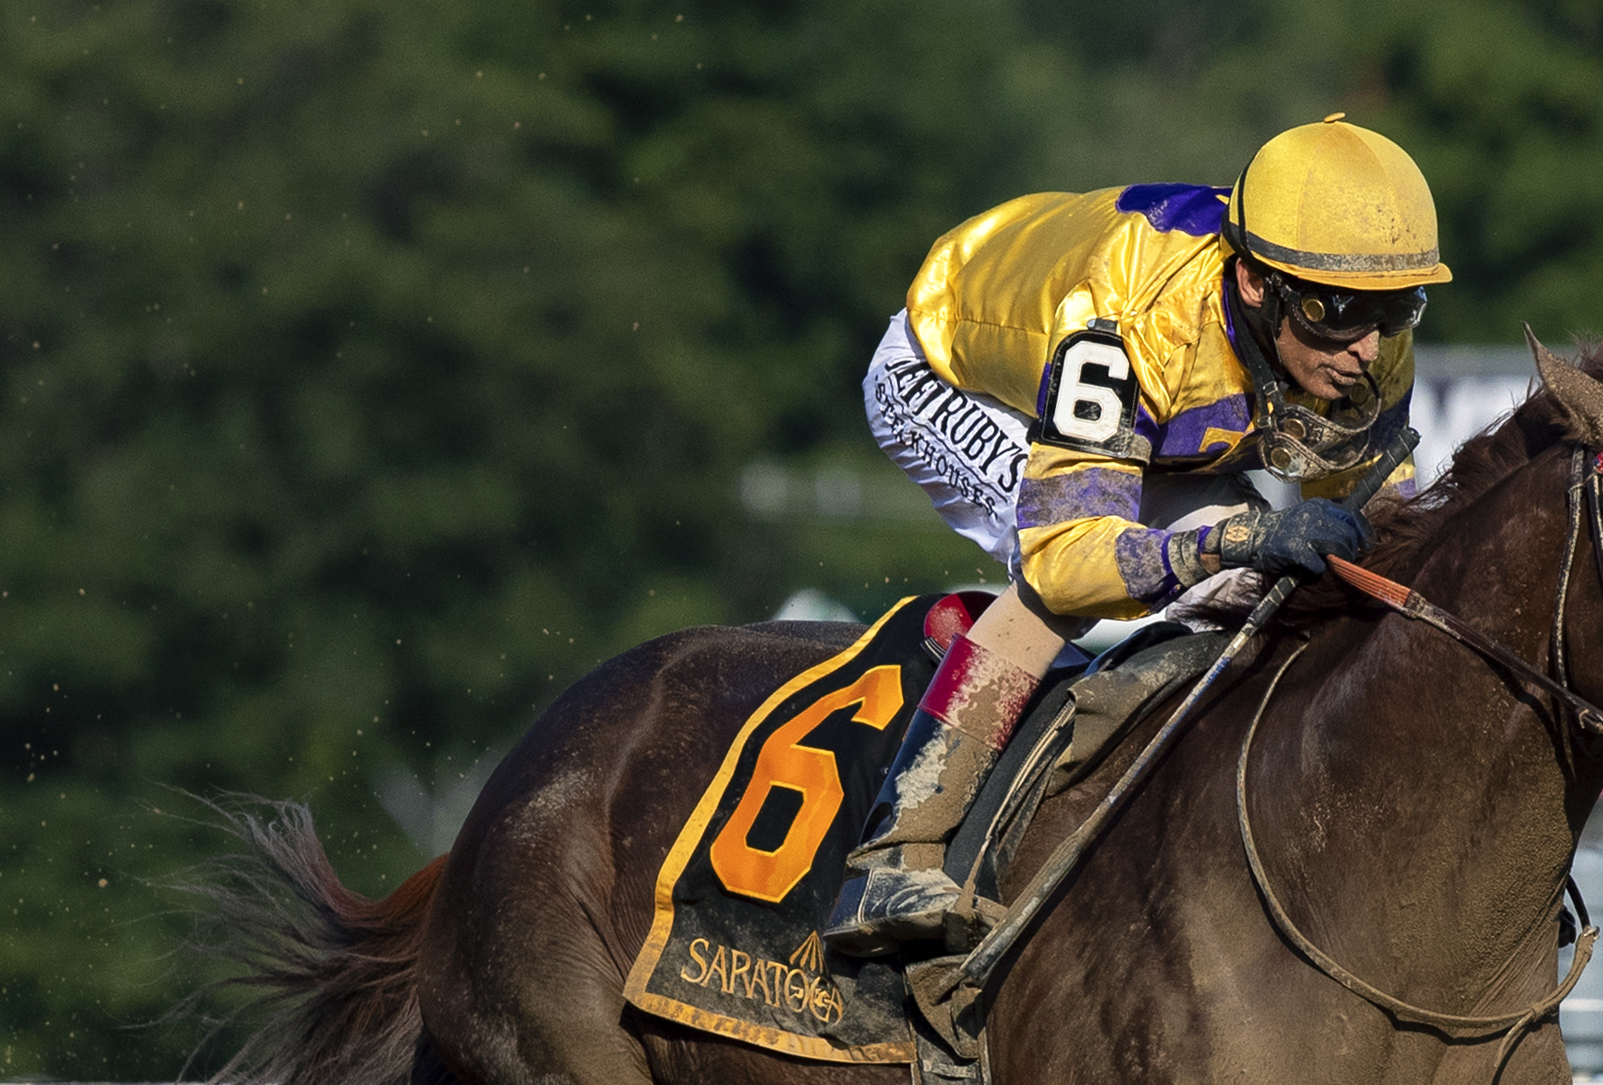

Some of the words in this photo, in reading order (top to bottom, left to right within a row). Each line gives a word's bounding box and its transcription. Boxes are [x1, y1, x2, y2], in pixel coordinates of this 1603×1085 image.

[928, 387, 1029, 493] RUBY'S
[1052, 340, 1131, 442] 6
[875, 383, 998, 518] STEAKHOUSES
[709, 664, 905, 904] 6
[680, 937, 844, 1028] SARATOGA
